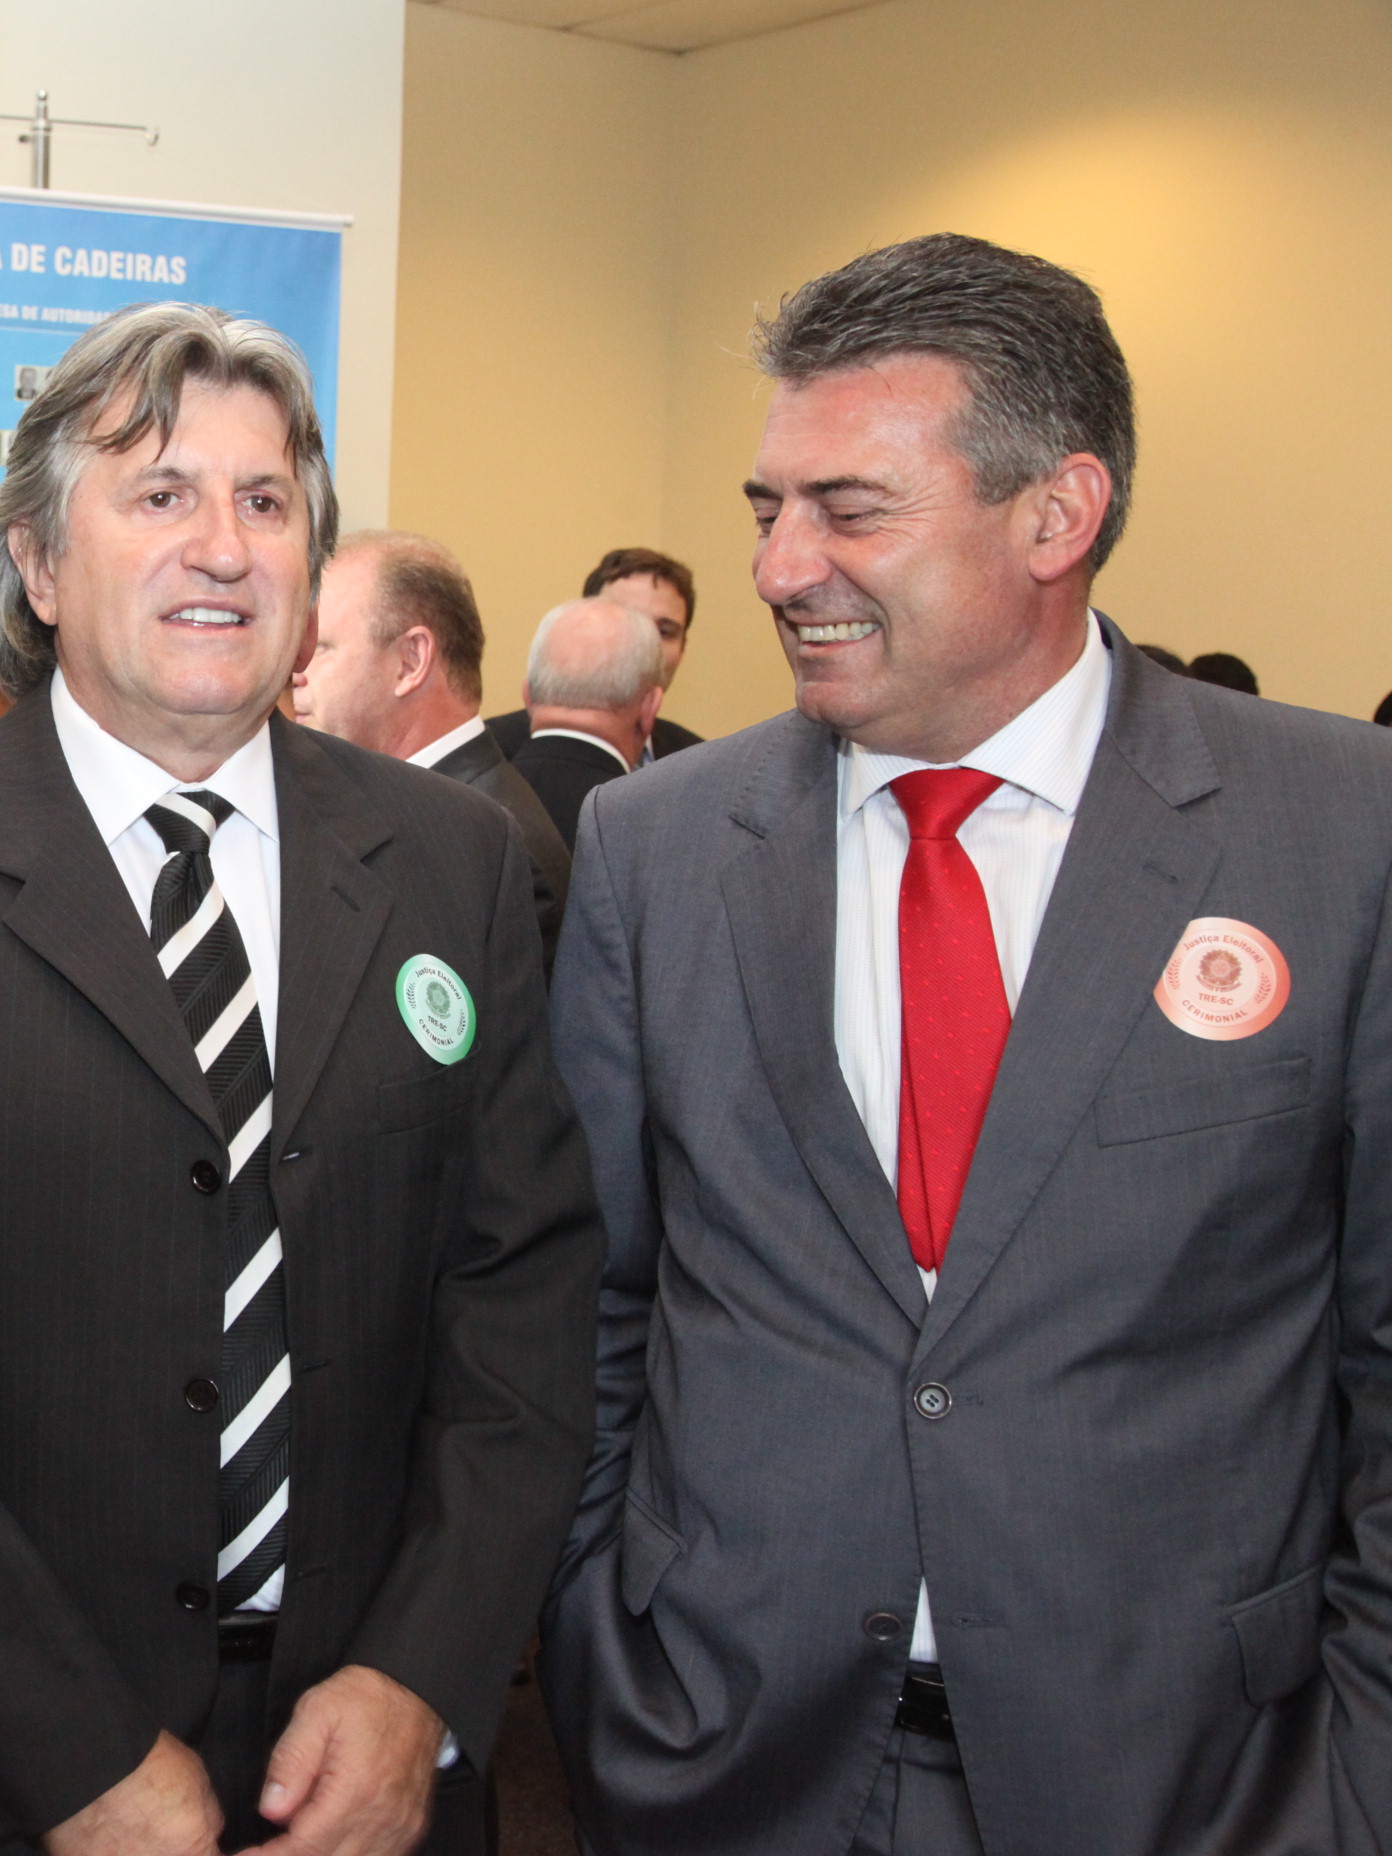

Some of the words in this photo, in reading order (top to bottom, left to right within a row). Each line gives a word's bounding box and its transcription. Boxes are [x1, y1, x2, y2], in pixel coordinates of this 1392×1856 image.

[11, 243, 46, 273] DE
[54, 247, 187, 285] CADEIRAS
[21, 305, 39, 321] DE
[1184, 934, 1220, 951] Justiça
[1223, 935, 1264, 964] Eleitoral
[415, 966, 436, 978] Justiça
[437, 970, 462, 1000] Eleitoral
[1182, 999, 1248, 1023] CERIMONIAL
[1198, 993, 1234, 1006] TRE-SC
[418, 1019, 454, 1046] CERIMONIAL
[427, 1015, 447, 1032] TRE-SC
